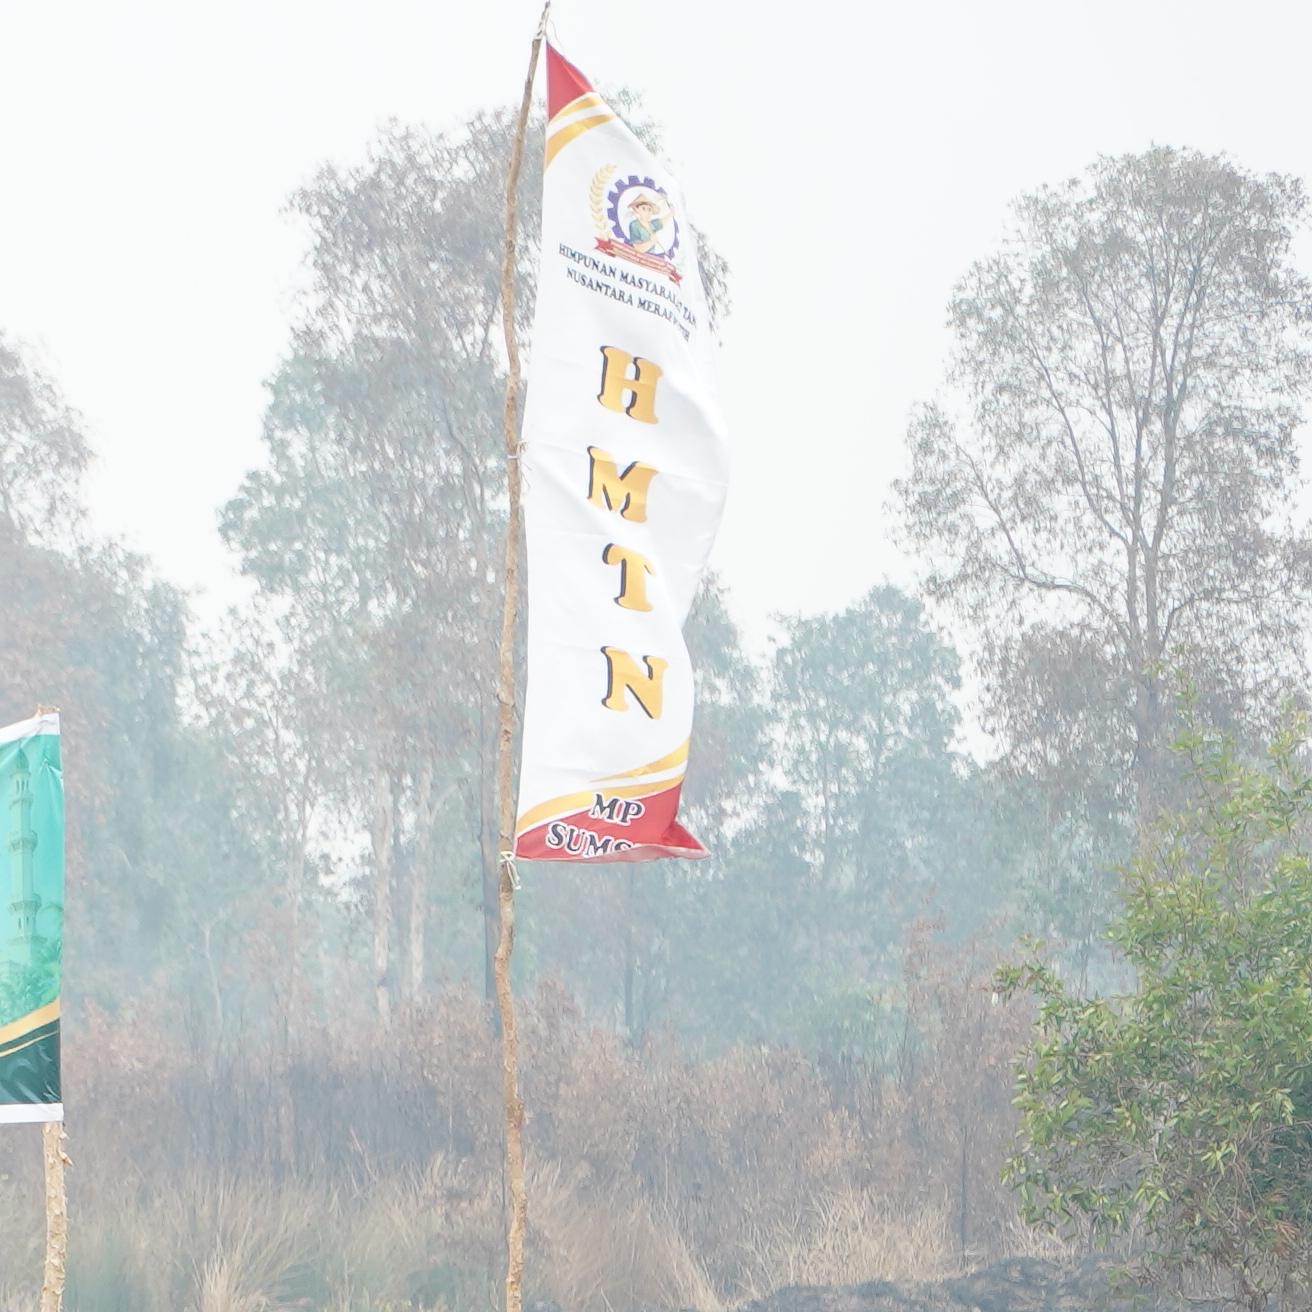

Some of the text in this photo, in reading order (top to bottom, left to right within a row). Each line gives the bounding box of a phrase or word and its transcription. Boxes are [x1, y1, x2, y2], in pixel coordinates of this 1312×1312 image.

[559, 243, 617, 277] HIMPUNAN
[567, 267, 633, 306] NUSANTARA
[587, 345, 669, 720] HMTN
[592, 793, 643, 824] MP
